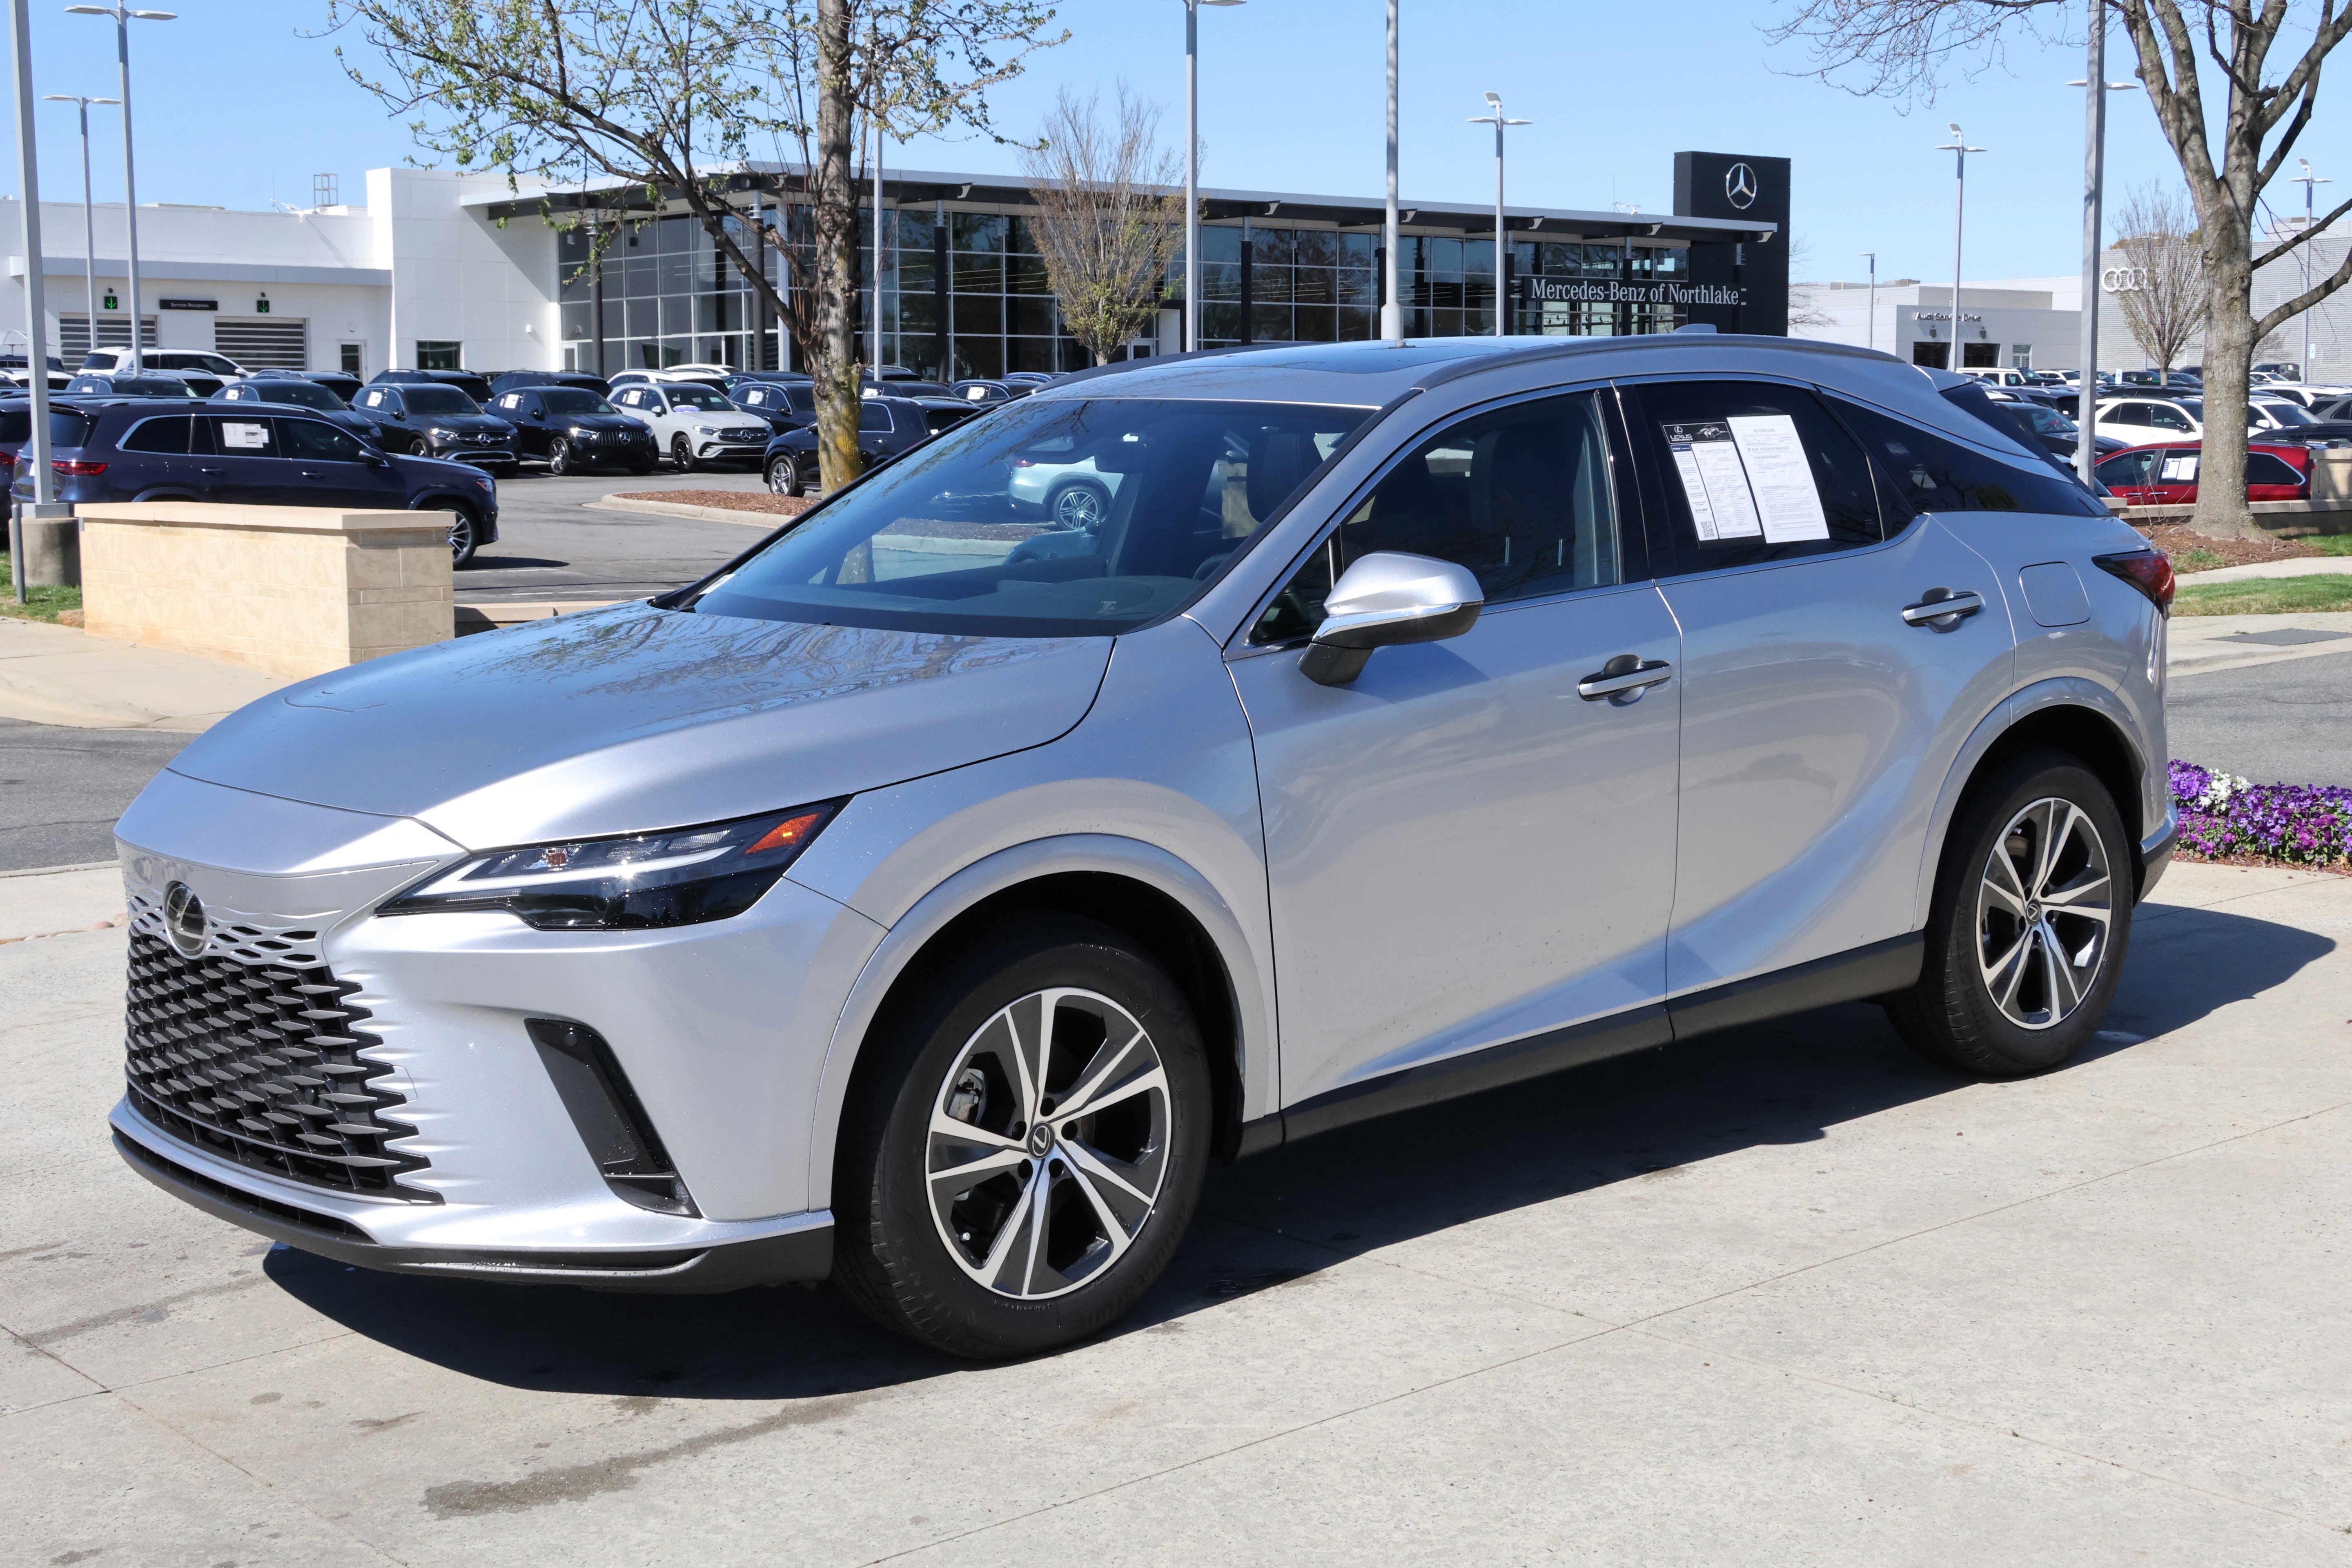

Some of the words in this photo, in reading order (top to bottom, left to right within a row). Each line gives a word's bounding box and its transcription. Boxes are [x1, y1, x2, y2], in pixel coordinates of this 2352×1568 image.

[1531, 278, 1646, 302] Mercedes-Benz
[1650, 283, 1665, 302] of
[1668, 284, 1738, 305] Northlake
[1914, 312, 1933, 321] Audi
[1935, 313, 1961, 321] Serve
[1962, 314, 1981, 322] Drive
